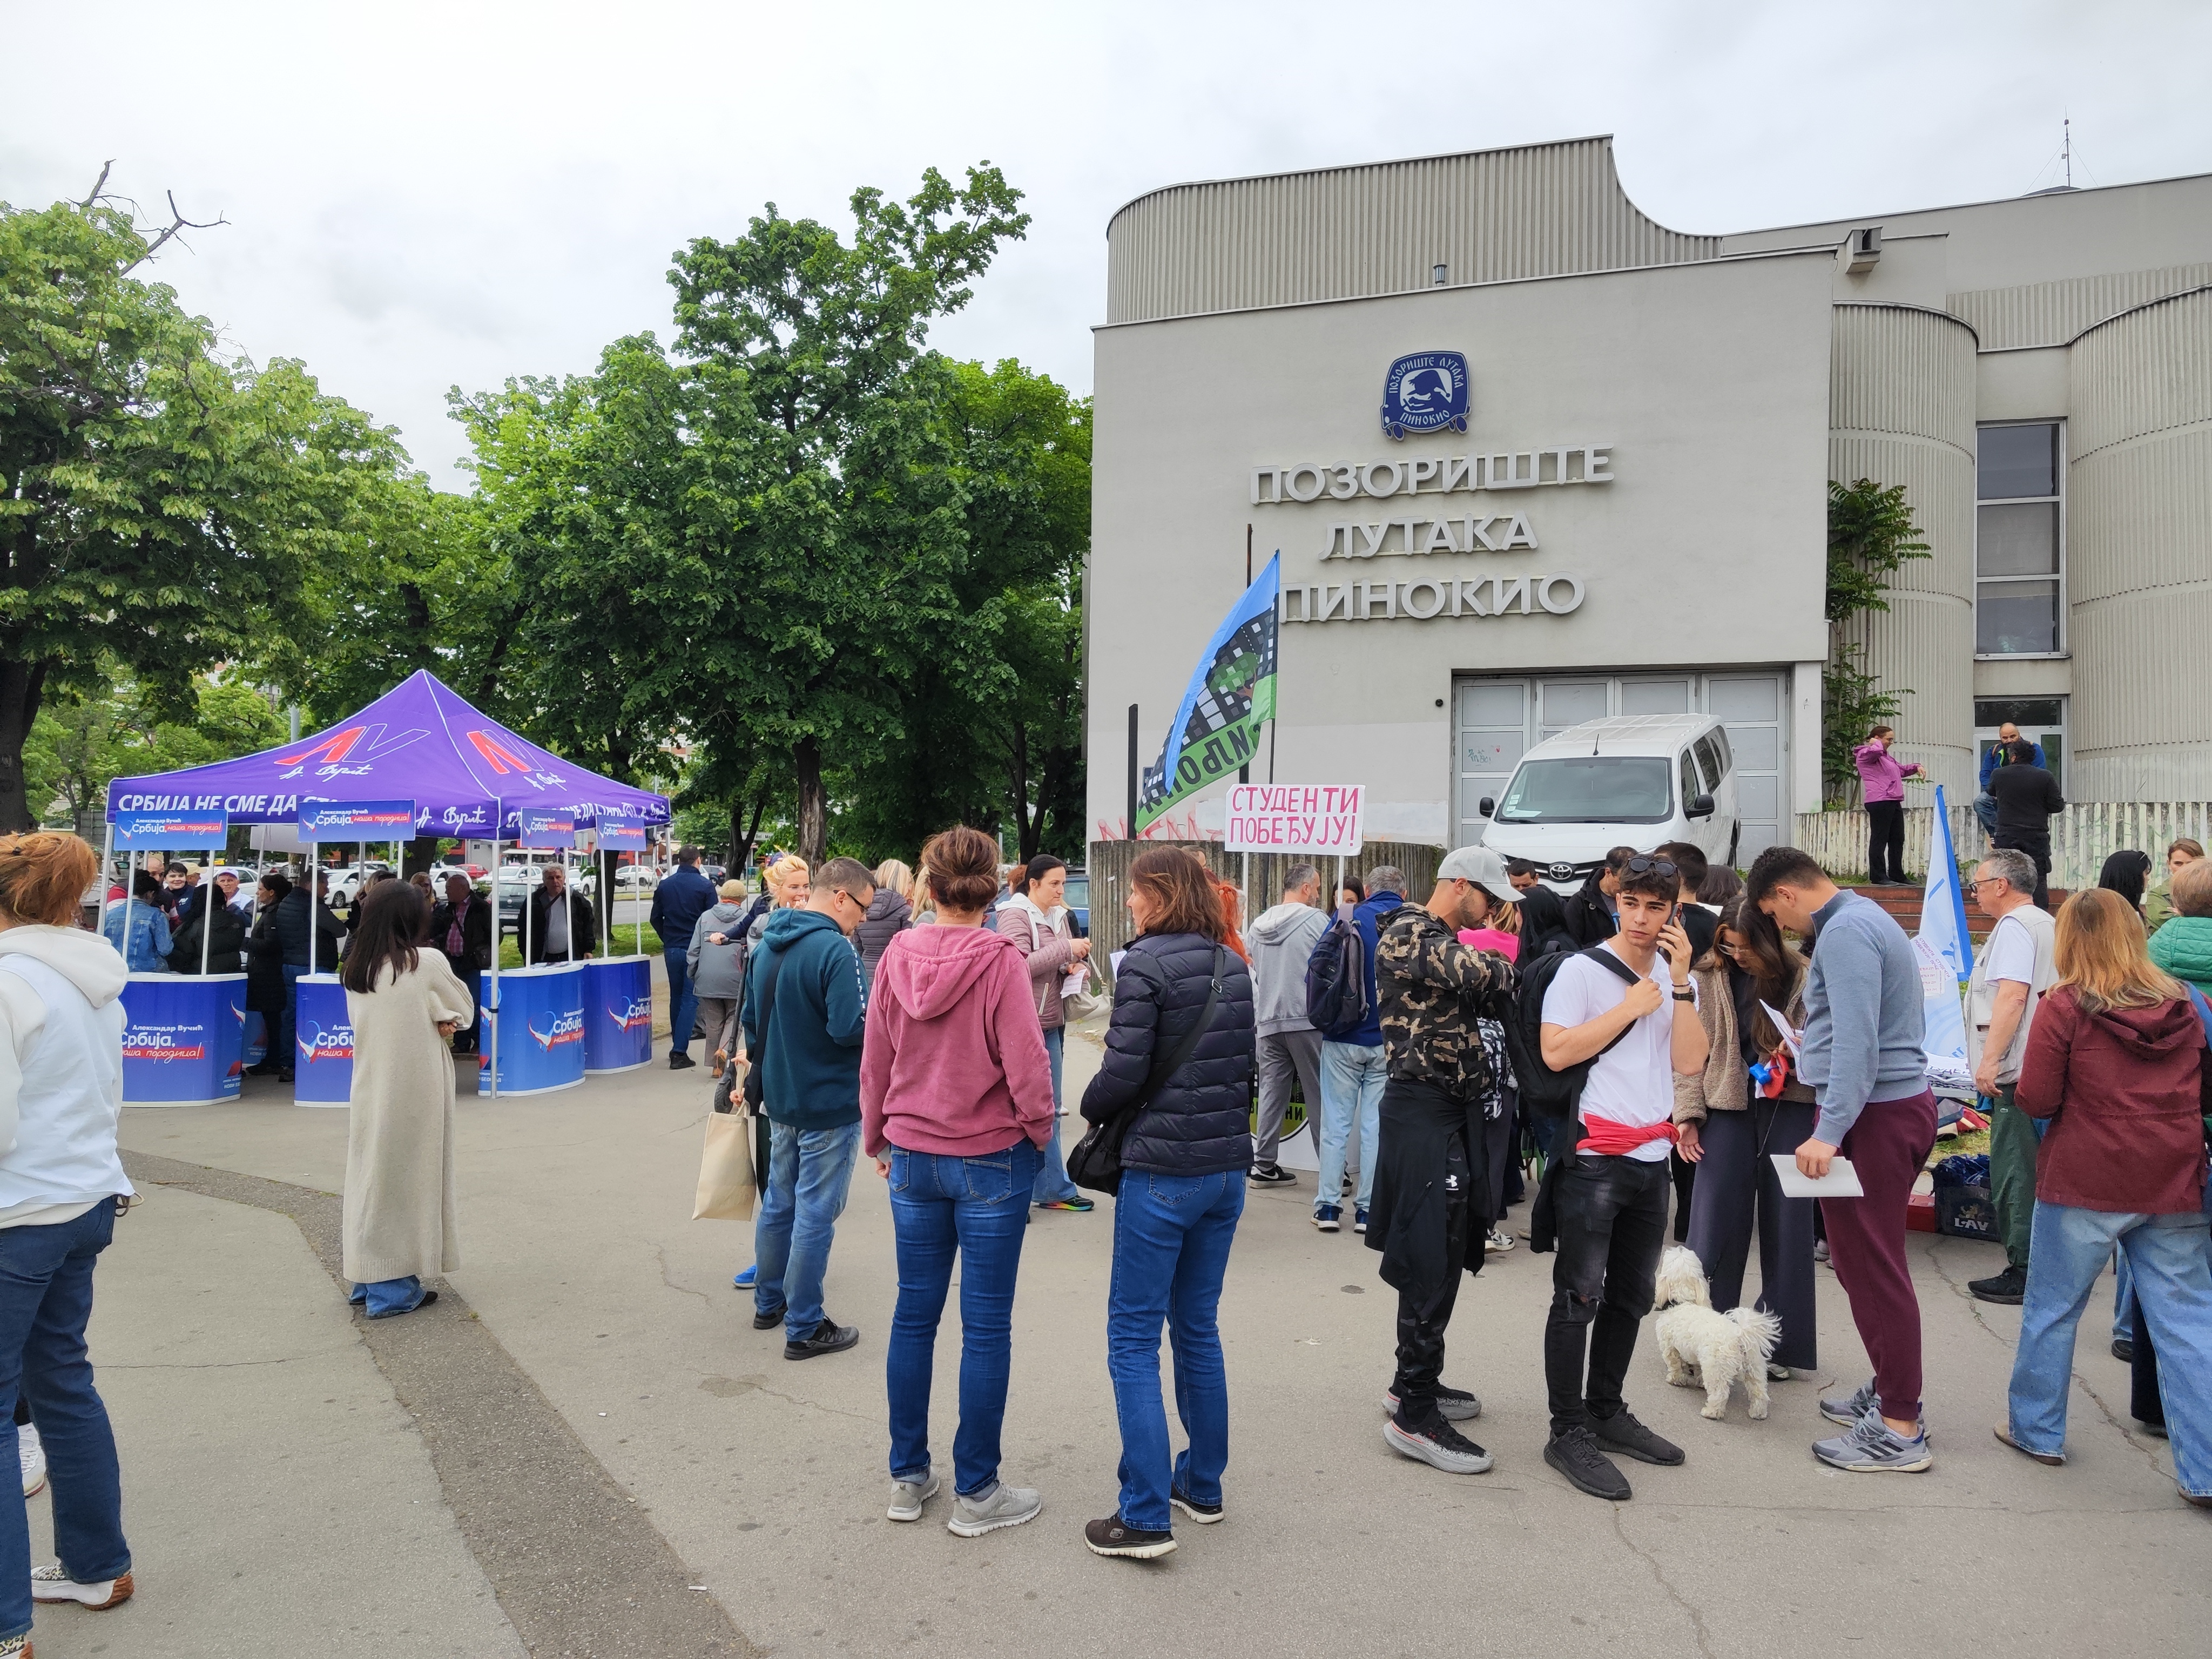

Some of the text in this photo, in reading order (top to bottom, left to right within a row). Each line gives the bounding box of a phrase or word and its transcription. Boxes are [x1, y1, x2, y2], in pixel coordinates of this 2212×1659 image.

[1388, 357, 1464, 393] ПОЗОРИШТЕ ЛУТАКА
[1400, 410, 1449, 425] ПИНОКИО
[1251, 442, 1614, 505] ПОЗОРИШТЕ
[1318, 510, 1538, 560] ЛУТАКА
[1279, 571, 1584, 623] ПИНОКИО
[118, 794, 189, 811] СРБИЈА
[194, 795, 222, 810] НЕ
[224, 795, 268, 813] СМЕ
[267, 794, 297, 816] ДА
[1232, 787, 1359, 813] СТУДЕНТИ
[132, 824, 167, 835] Србија,
[187, 819, 222, 836] породица!
[316, 814, 353, 826] Србија,
[374, 810, 410, 827] породица!
[1230, 815, 1356, 846] ПОБЕЂУЈУ!
[132, 1024, 203, 1033] Александар Вучић
[121, 1031, 176, 1049] Србија,
[316, 1031, 354, 1049] Срби
[146, 1042, 202, 1064] породица!
